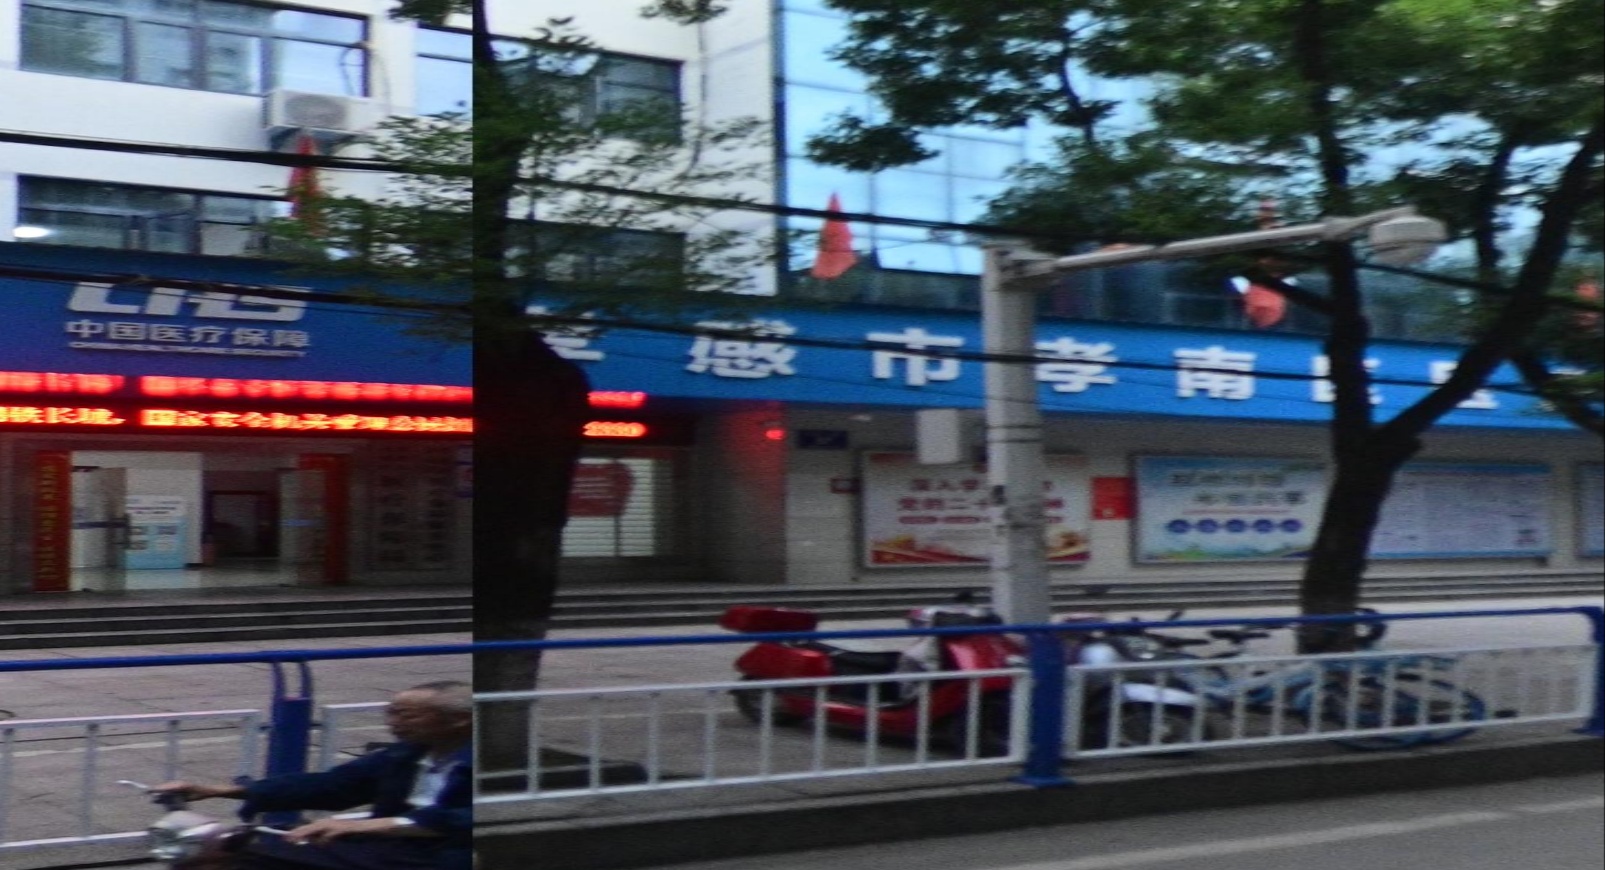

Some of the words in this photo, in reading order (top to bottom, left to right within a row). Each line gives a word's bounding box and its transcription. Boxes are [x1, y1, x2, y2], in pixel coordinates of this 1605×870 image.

[66, 318, 310, 348] 中国医疗保障
